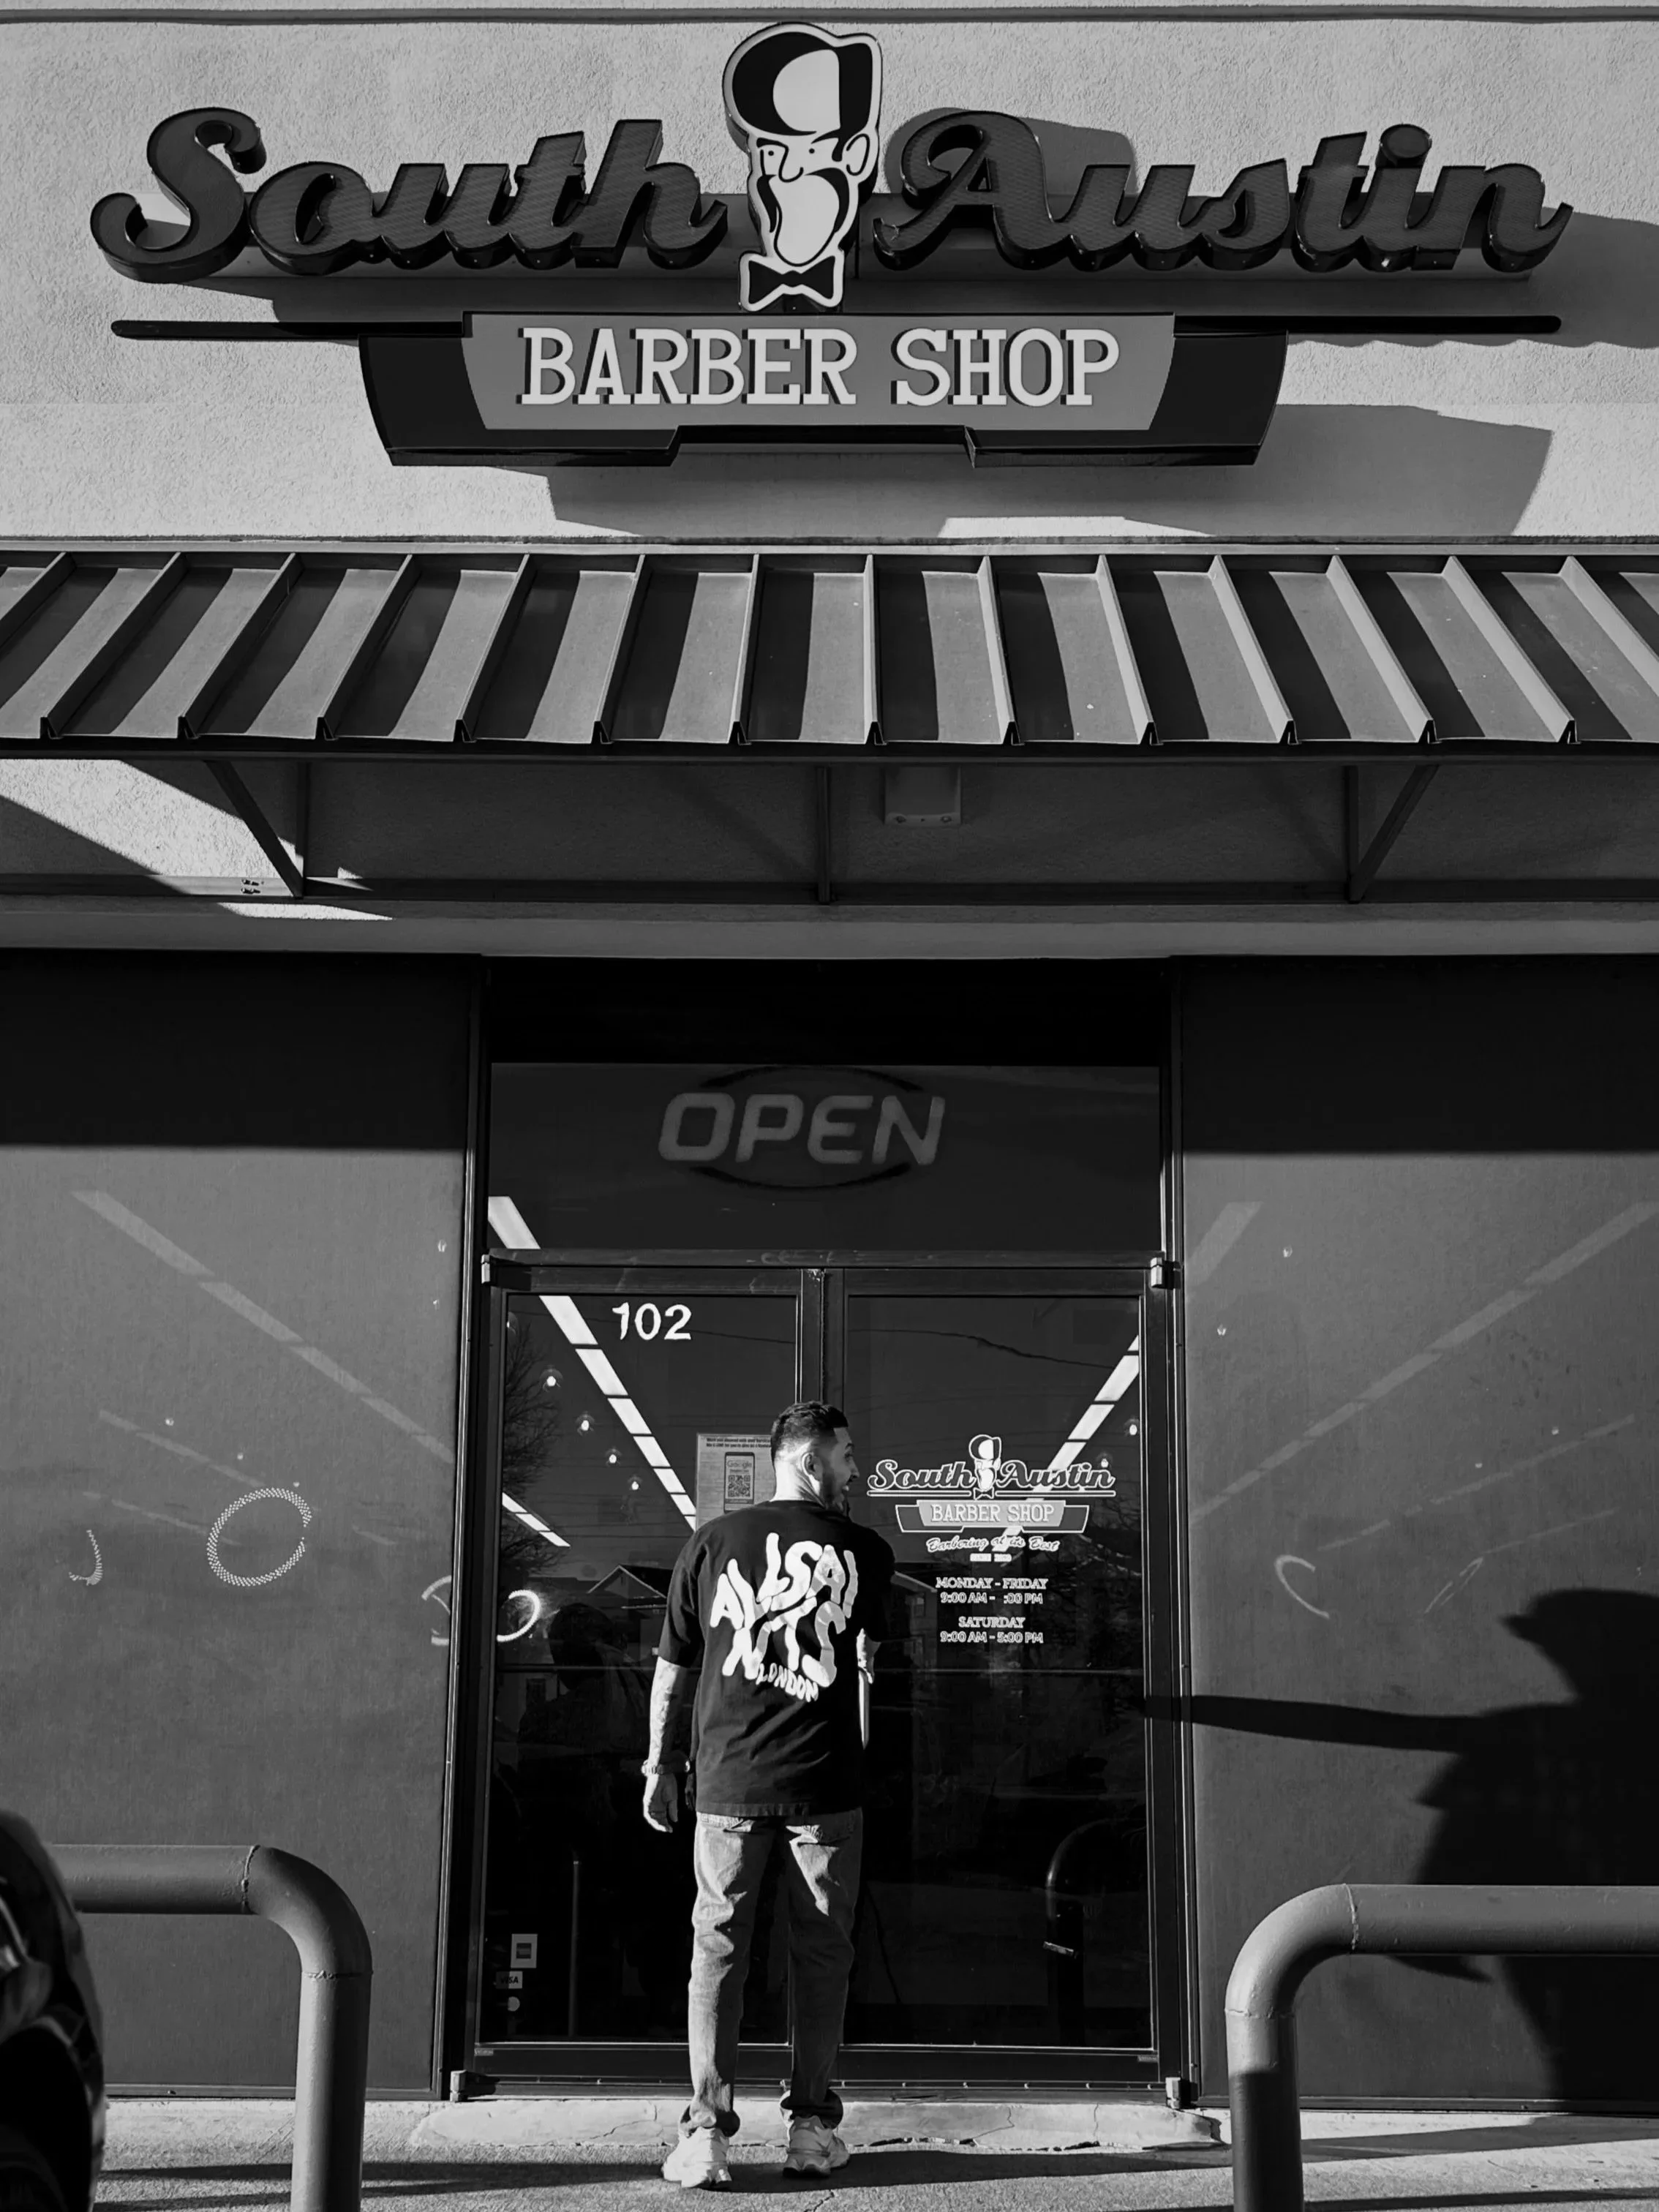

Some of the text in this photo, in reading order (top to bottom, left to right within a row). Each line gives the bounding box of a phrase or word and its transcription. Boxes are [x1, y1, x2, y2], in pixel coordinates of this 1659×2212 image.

[89, 106, 1574, 284] South Austin
[516, 326, 1121, 407] BARBER SHOP
[658, 1092, 947, 1166] OPEN
[612, 1301, 692, 1341] 102
[867, 1459, 1116, 1490] South Austin
[930, 1503, 1056, 1523] BARBER SHOP
[1028, 1536, 1060, 1551] Best
[936, 1577, 994, 1589] MONDAY
[1002, 1577, 1049, 1590] FRIDAY
[940, 1592, 967, 1603] 9:00
[967, 1592, 988, 1603] AM
[1024, 1592, 1044, 1604] PM
[958, 1615, 1026, 1628] SATURDAY
[940, 1630, 967, 1643] 9:00
[967, 1631, 988, 1643] AM
[997, 1631, 1023, 1643] 5:00
[1024, 1632, 1044, 1644] PM
[756, 1662, 819, 1703] LONDON
